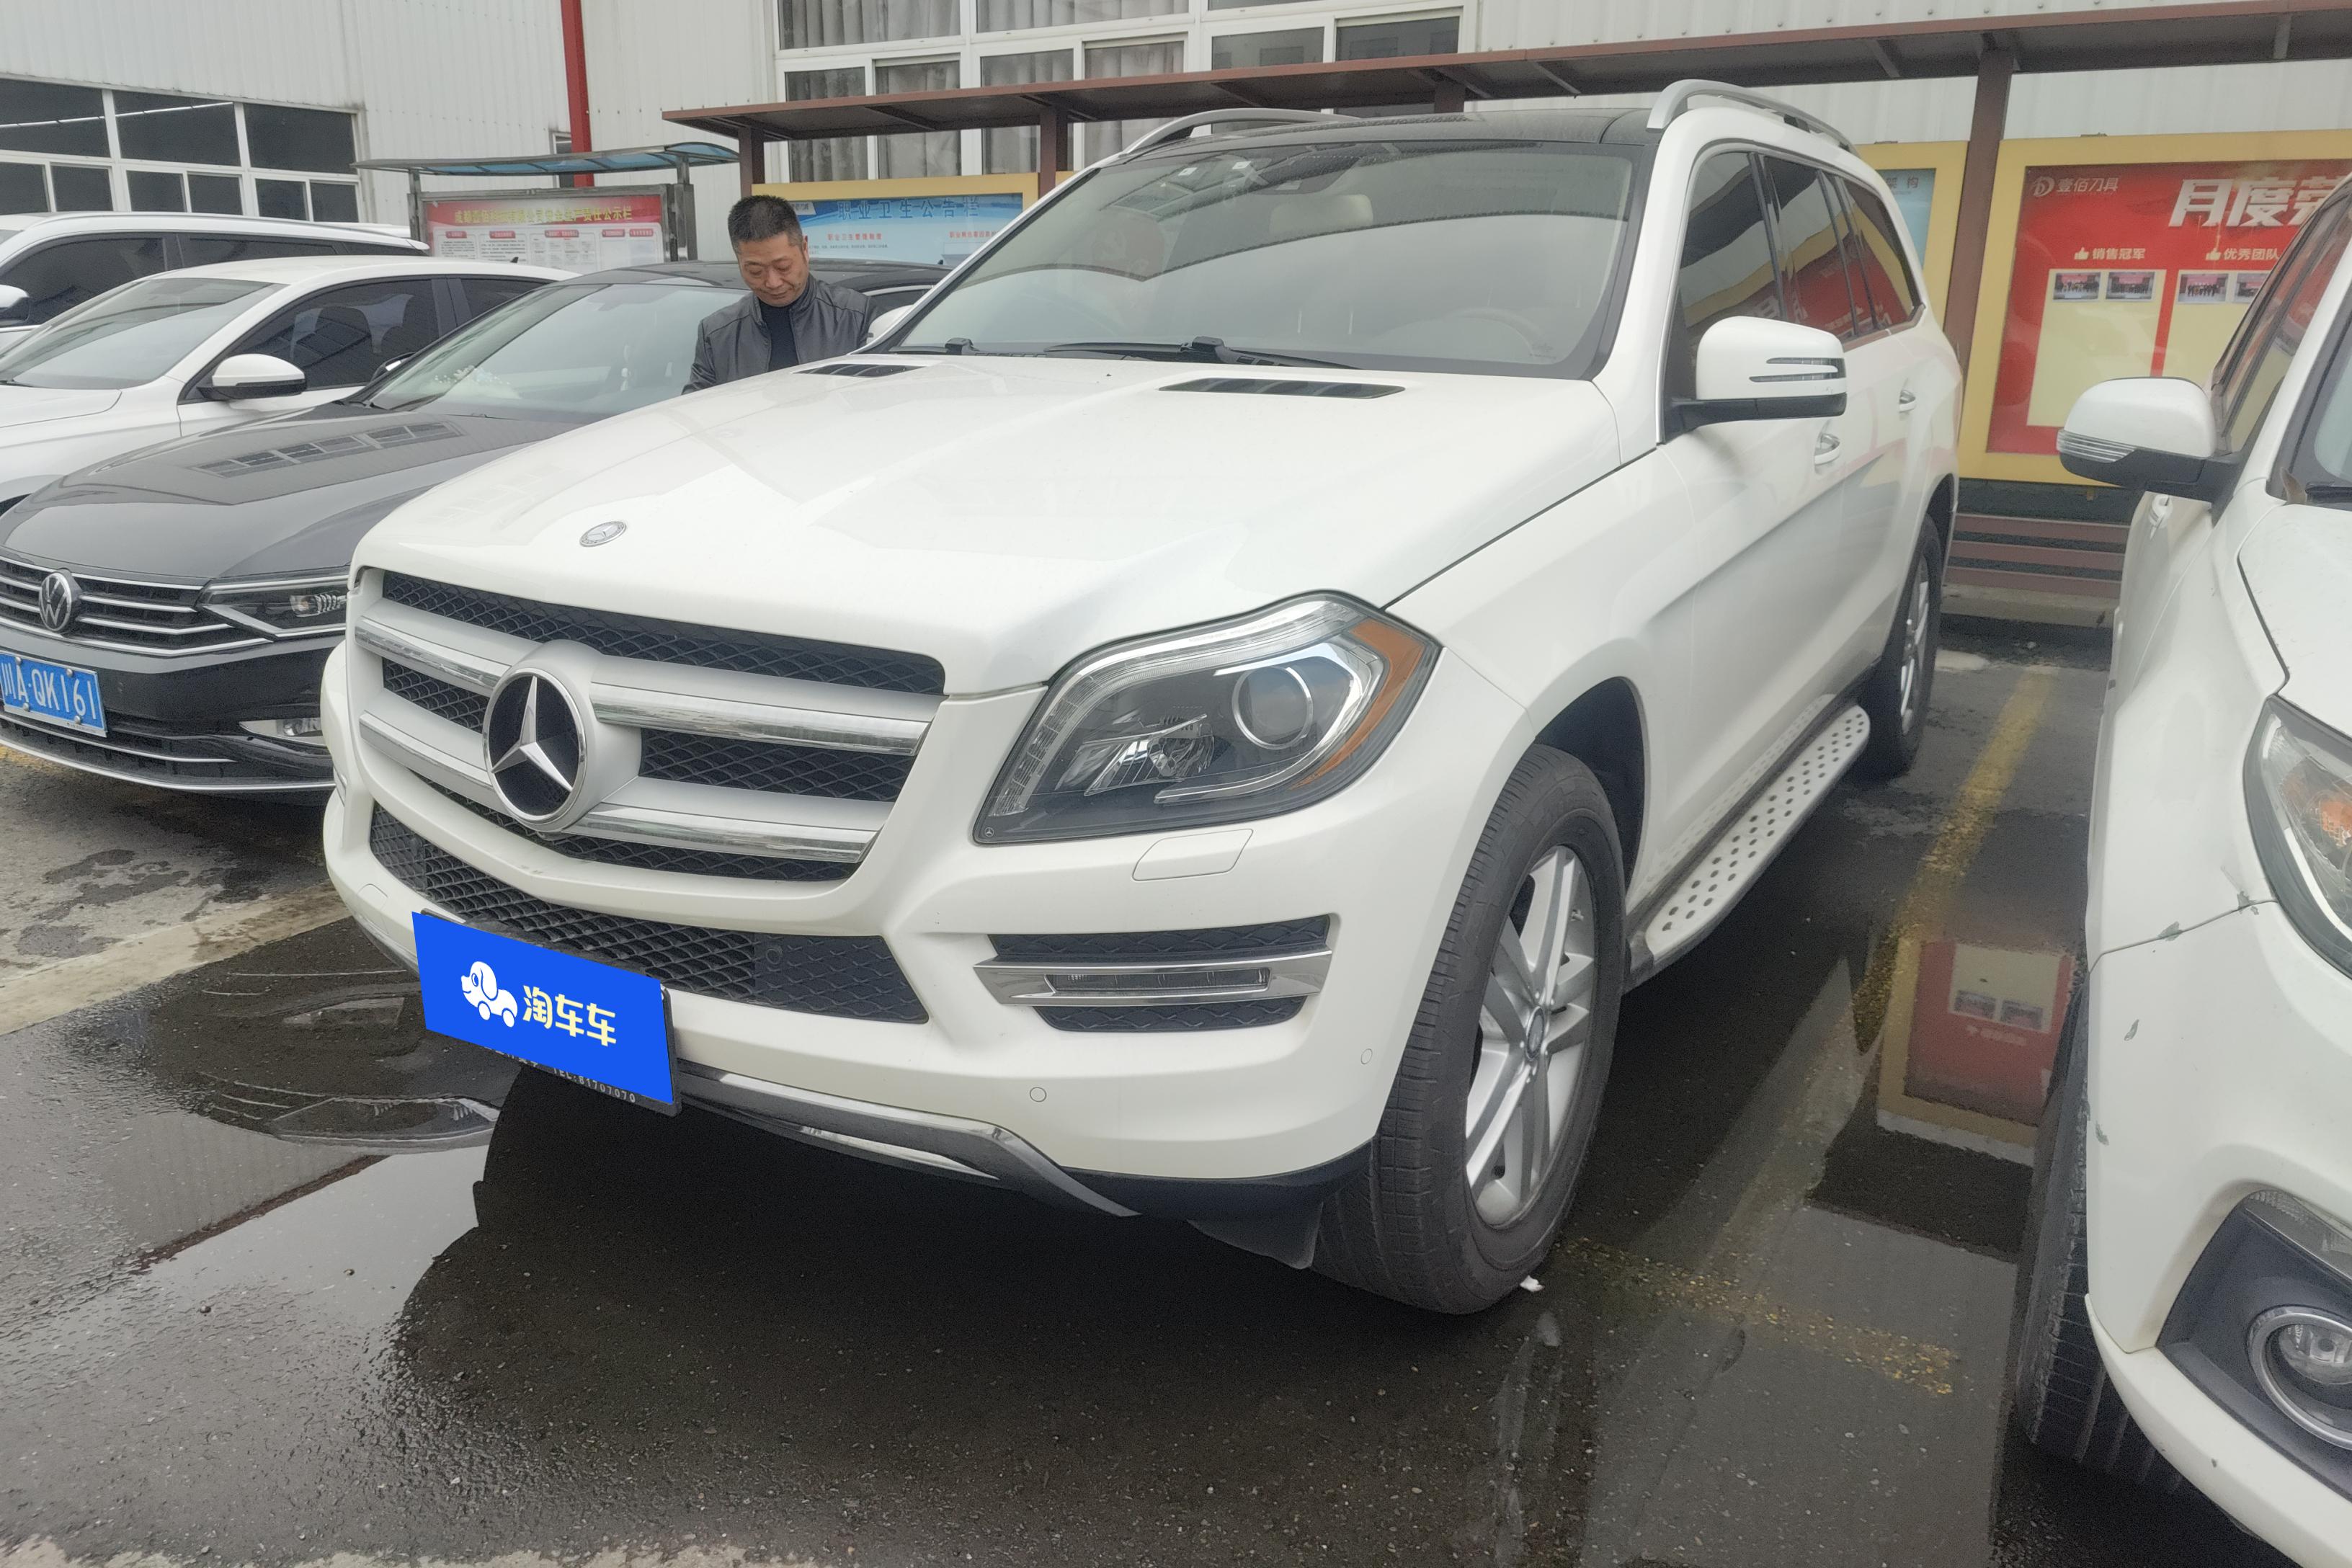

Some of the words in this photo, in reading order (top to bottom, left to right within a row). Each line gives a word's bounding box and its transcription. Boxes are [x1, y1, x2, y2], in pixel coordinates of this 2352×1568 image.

[2056, 177, 2119, 192] 壹佰刀具
[837, 197, 979, 220] 职业卫生公告栏
[2093, 248, 2145, 259] 销售冠军
[2224, 247, 2280, 260] 优秀团队
